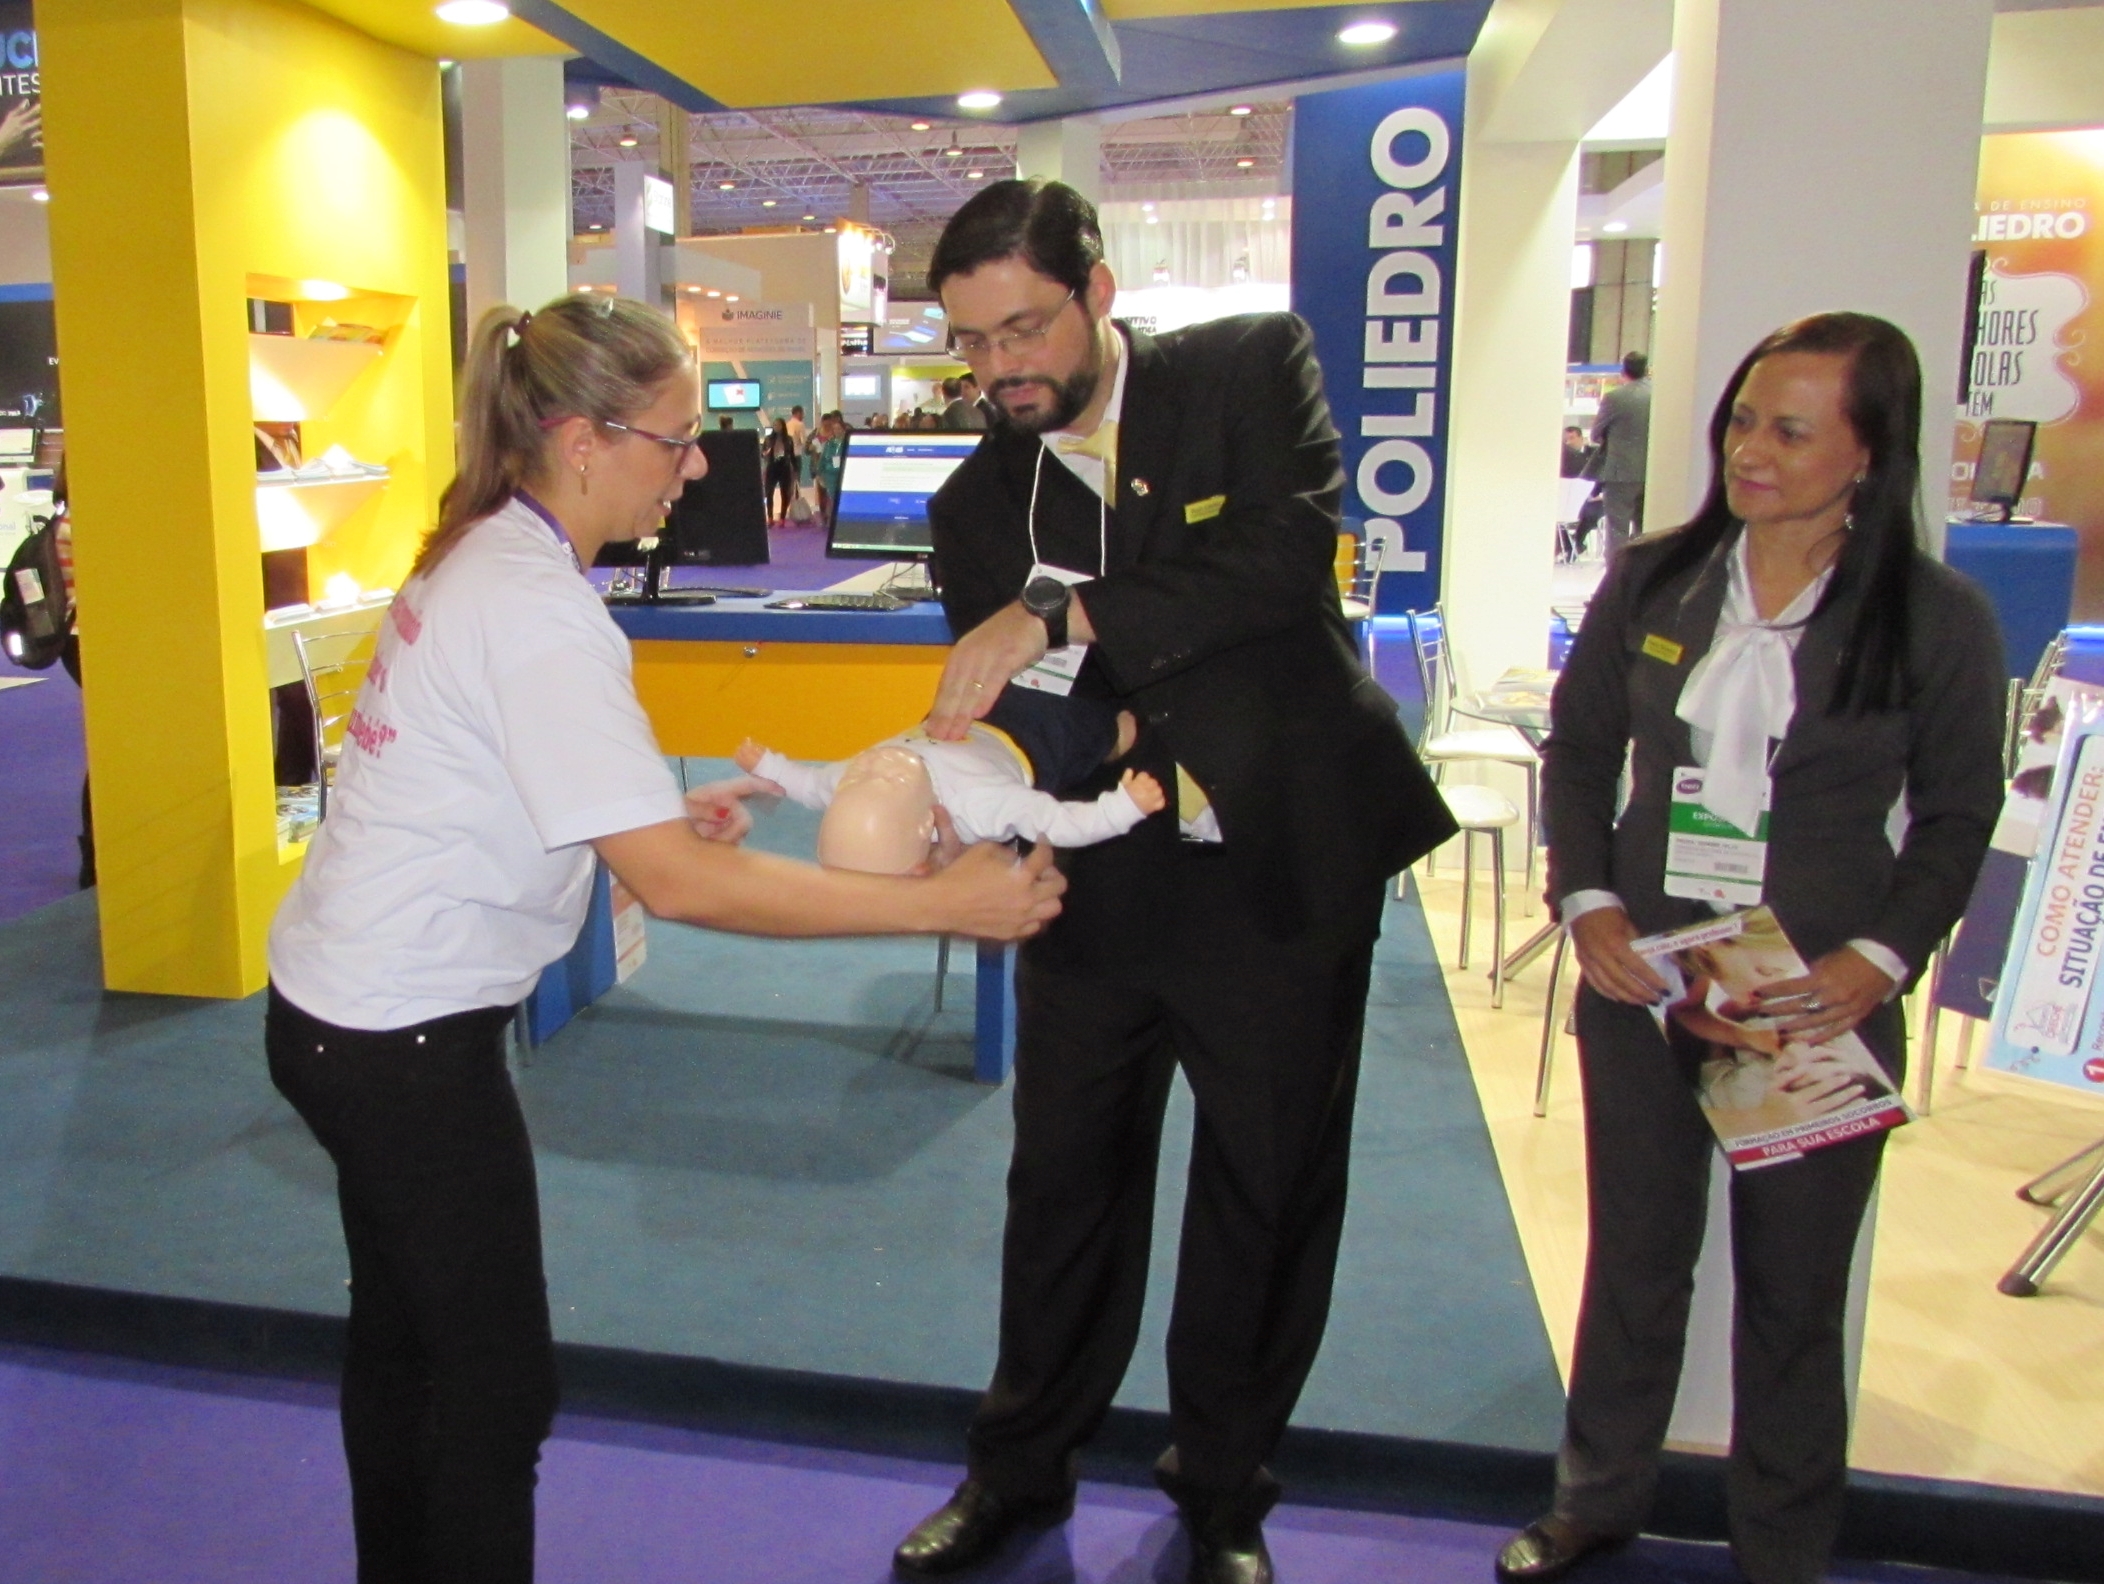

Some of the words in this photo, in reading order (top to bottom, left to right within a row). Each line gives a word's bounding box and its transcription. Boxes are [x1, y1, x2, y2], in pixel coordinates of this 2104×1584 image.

[2020, 199, 2087, 210] ENSINO
[737, 310, 783, 320] IMAGINIE
[1356, 107, 1450, 572] POLIEDRO
[2037, 884, 2072, 957] COMO
[2057, 765, 2104, 880] ATENDER:
[2058, 883, 2104, 989] SITUAÇÃO
[1762, 1141, 1795, 1157] PARA
[1798, 1133, 1826, 1149] SUA
[1828, 1117, 1881, 1140] ESCOLA
